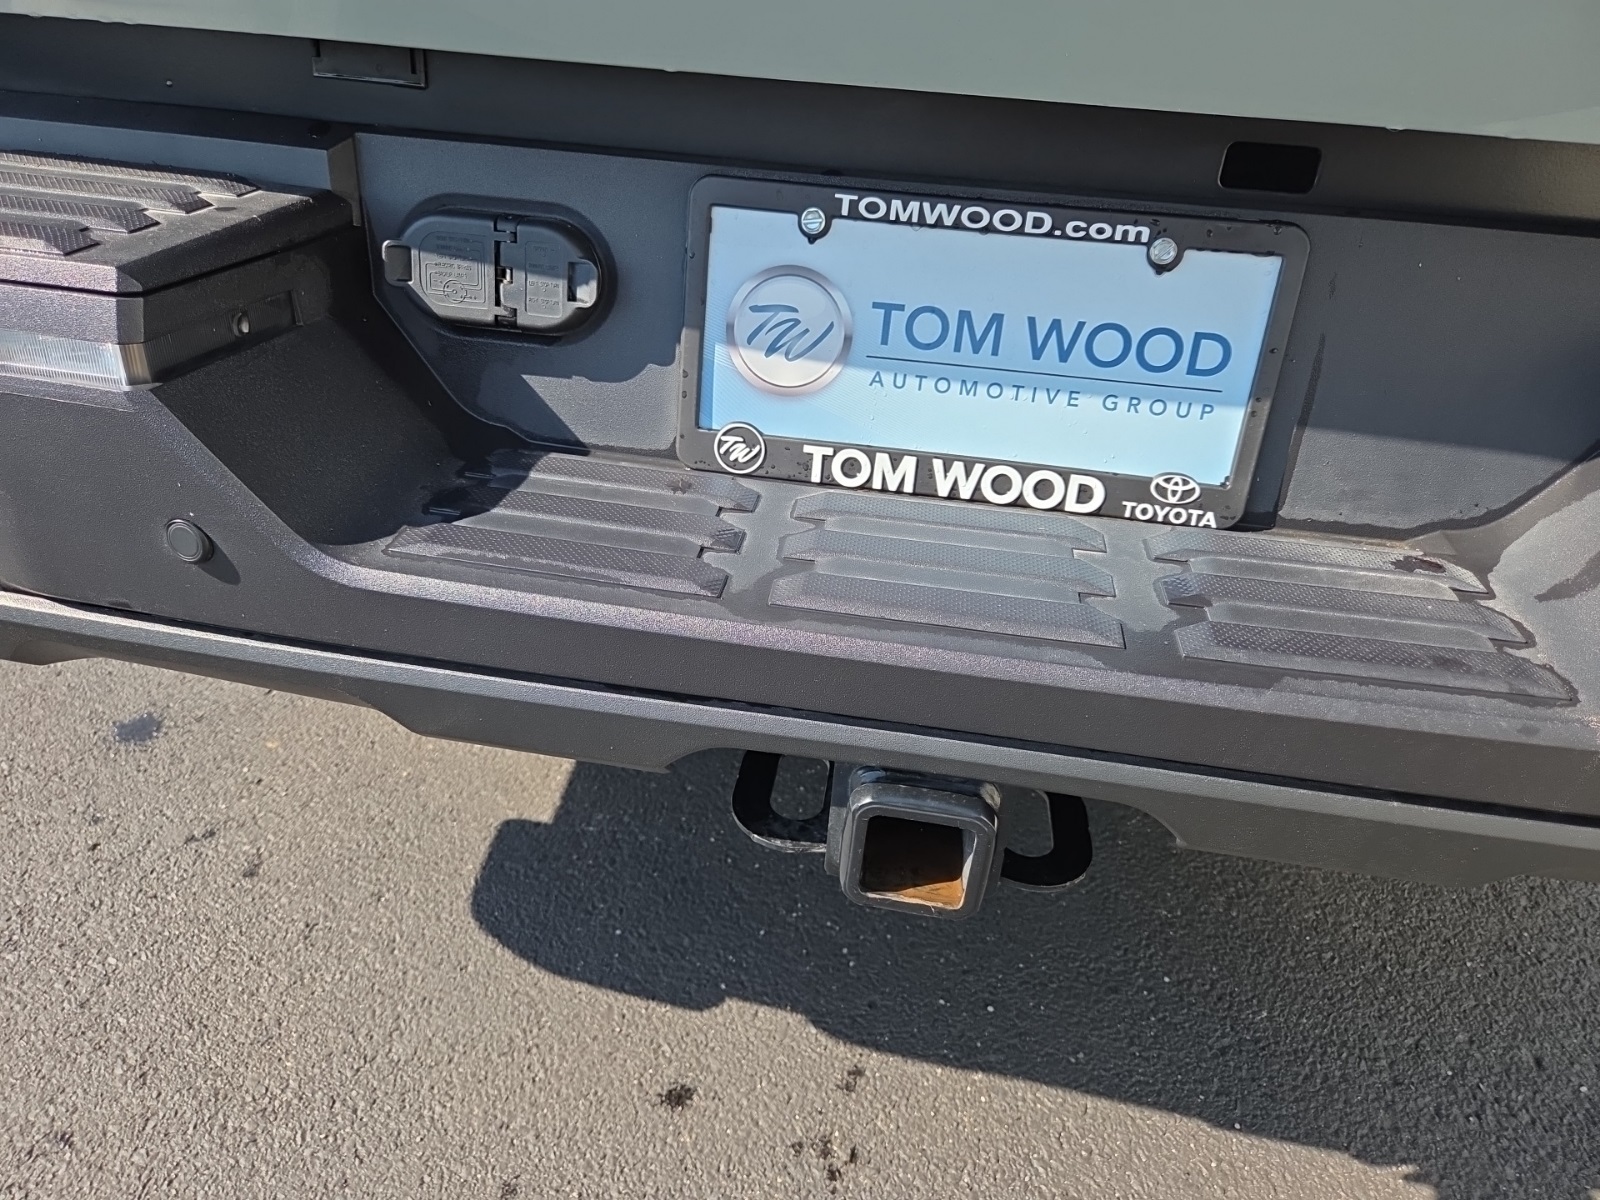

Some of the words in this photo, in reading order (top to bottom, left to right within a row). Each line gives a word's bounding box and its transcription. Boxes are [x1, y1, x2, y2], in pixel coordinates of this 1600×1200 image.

[834, 193, 1150, 243] TOMWOOD.com
[872, 302, 1005, 357] TOM
[1027, 316, 1232, 377] WOOD
[869, 370, 1081, 408] AUTOMOTIVE
[1102, 394, 1216, 420] GROUP
[803, 444, 918, 493] TOM
[932, 458, 1106, 514] WOOD
[1121, 501, 1218, 529] TOYOTA
